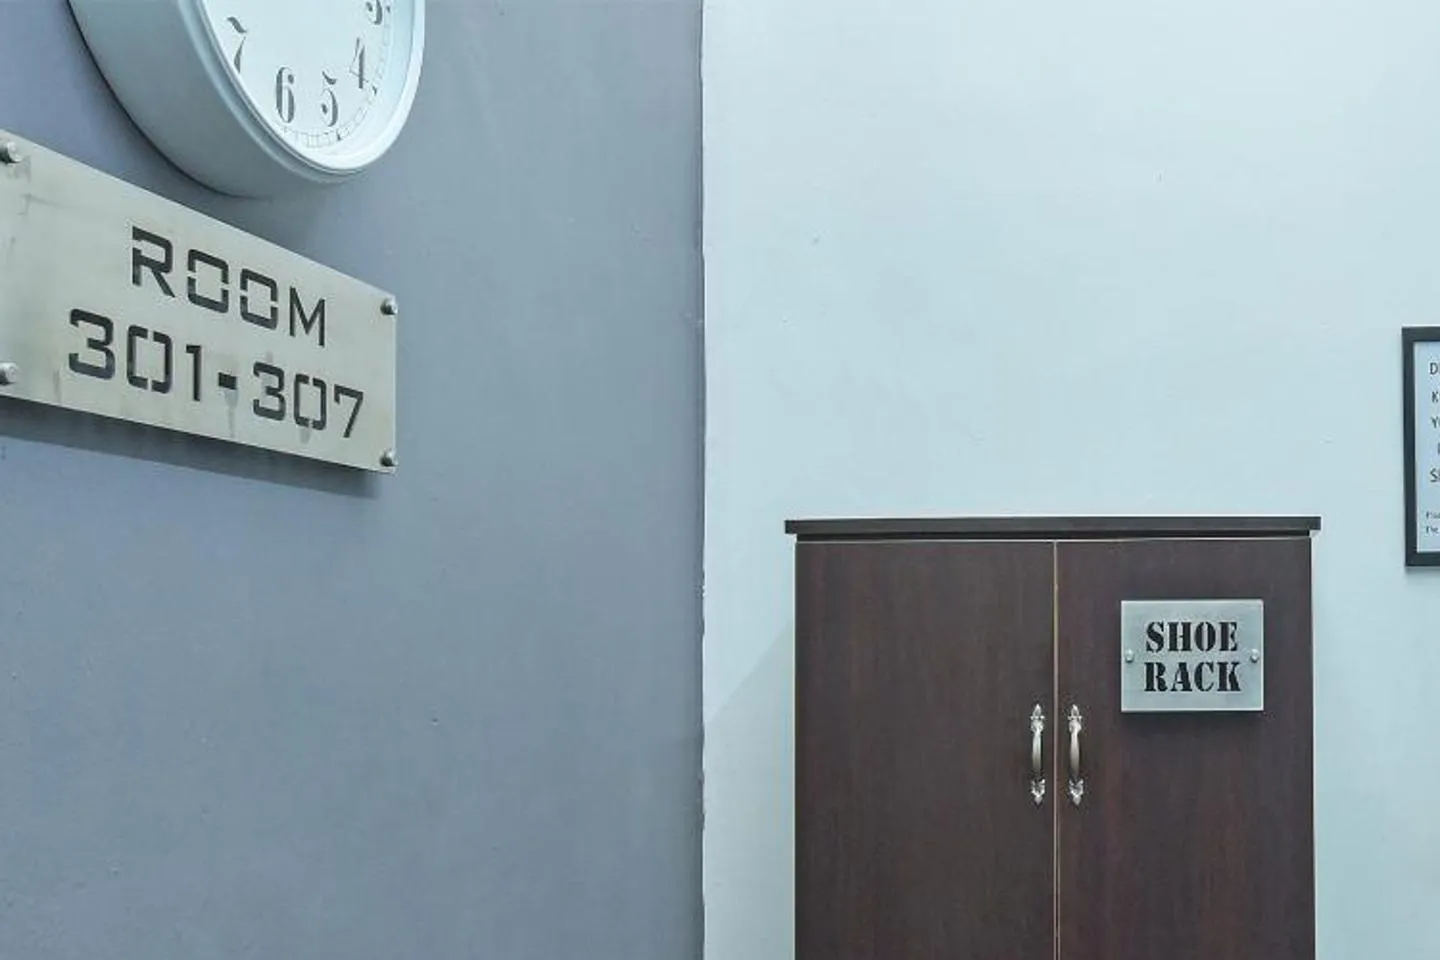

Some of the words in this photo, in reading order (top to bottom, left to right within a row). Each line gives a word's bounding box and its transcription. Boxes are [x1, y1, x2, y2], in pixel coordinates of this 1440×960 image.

[227, 17, 247, 74] 7
[350, 37, 371, 89] 4
[276, 66, 295, 124] 6
[320, 71, 338, 127] 5
[131, 226, 326, 348] ROOM
[69, 308, 364, 439] 301-307
[1146, 621, 1239, 653] SHOE
[1144, 661, 1242, 692] RACK
